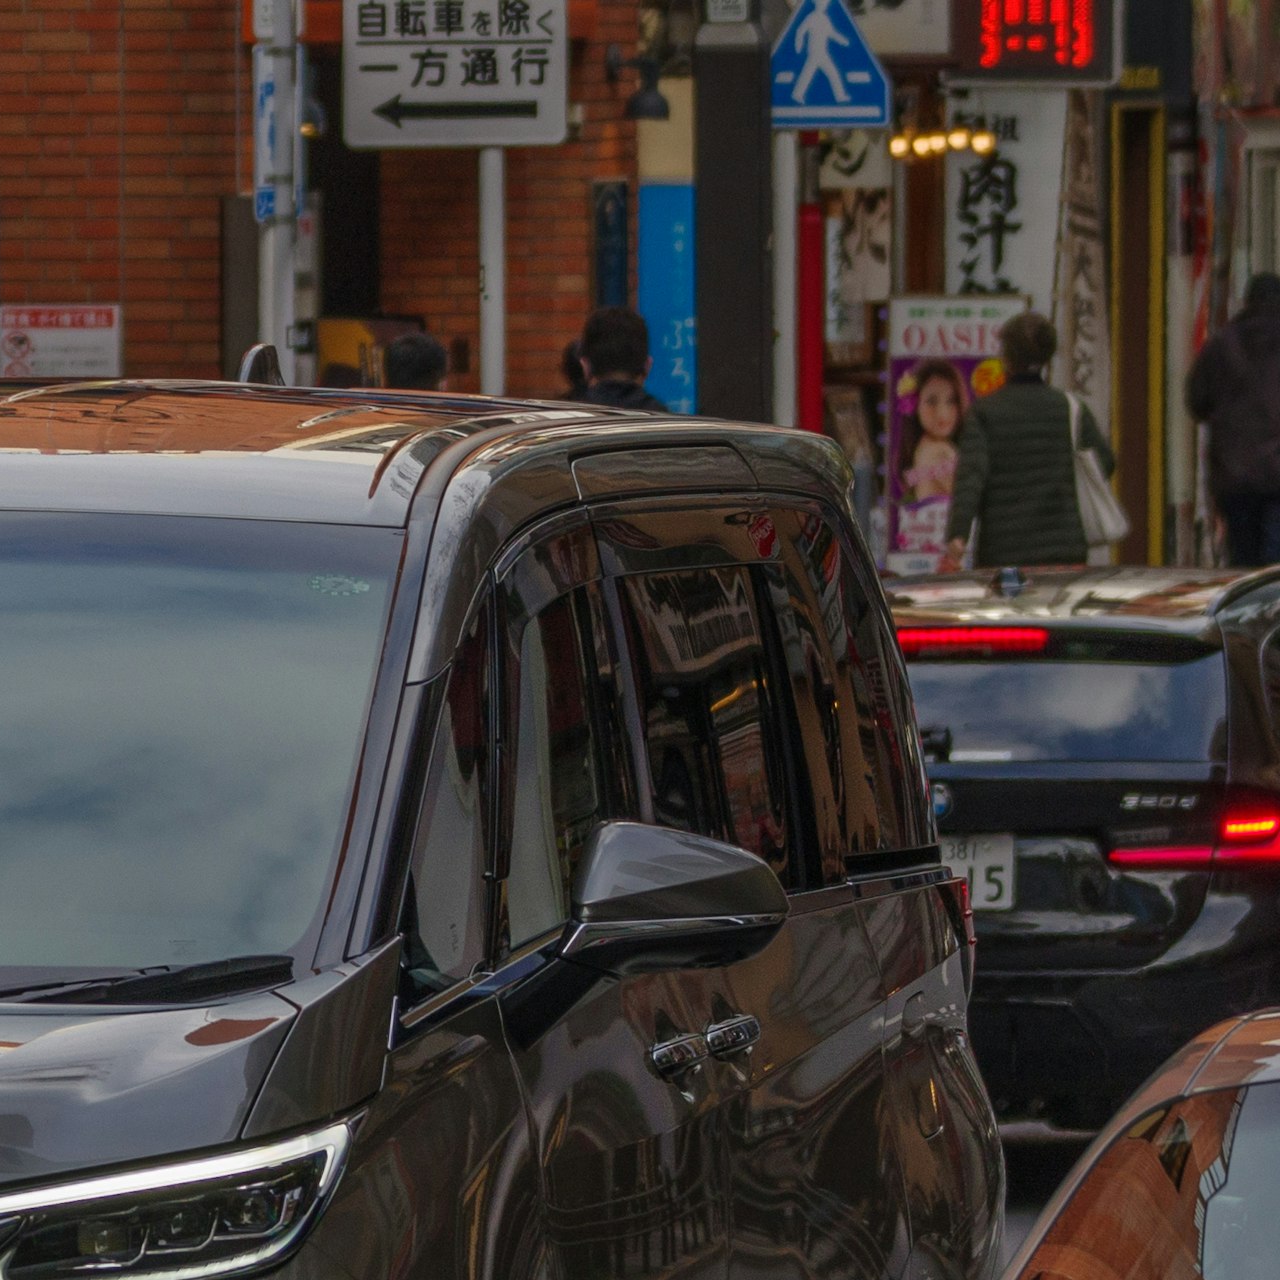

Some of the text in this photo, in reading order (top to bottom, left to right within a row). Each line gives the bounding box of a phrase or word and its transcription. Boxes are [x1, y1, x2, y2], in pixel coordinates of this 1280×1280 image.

[357, 0, 553, 37] 自転車を除く
[359, 47, 550, 88] 一方通行
[945, 842, 976, 862] 381
